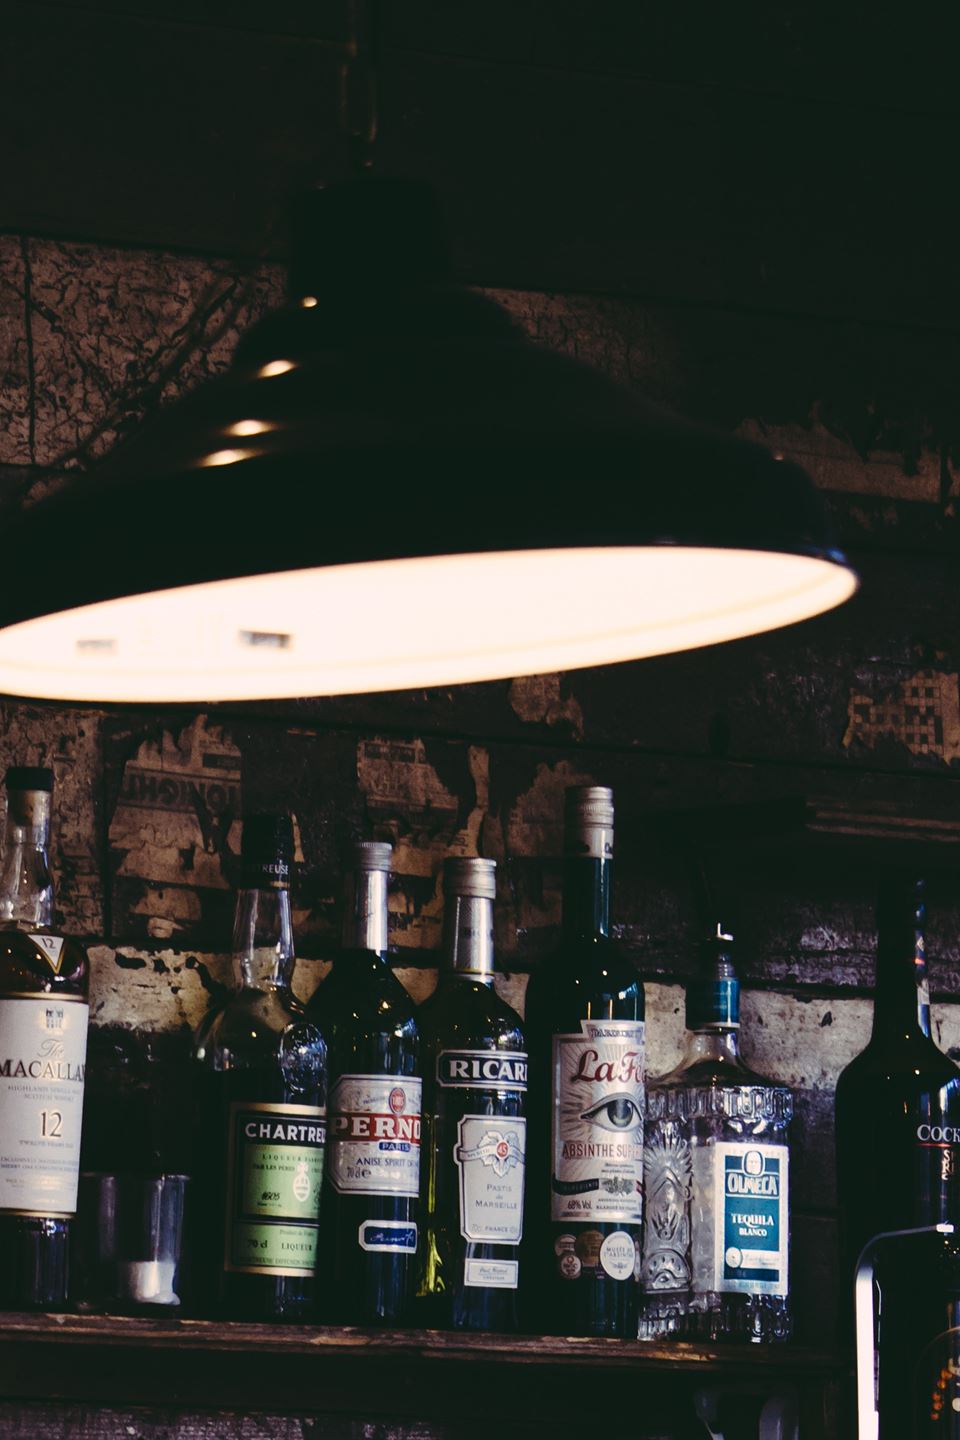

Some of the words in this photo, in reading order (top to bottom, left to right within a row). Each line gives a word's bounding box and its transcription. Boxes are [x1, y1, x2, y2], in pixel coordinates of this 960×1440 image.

[43, 937, 55, 949] 12
[37, 1038, 65, 1058] The
[572, 1049, 618, 1084] La
[40, 1111, 62, 1138] 12
[382, 1142, 410, 1152] PARIS
[562, 1143, 615, 1159] ABSINTHE
[356, 1158, 381, 1167] ANISE
[727, 1172, 779, 1196] OLMECA
[730, 1213, 775, 1229] TEQUILA
[738, 1227, 768, 1237] BLANCO
